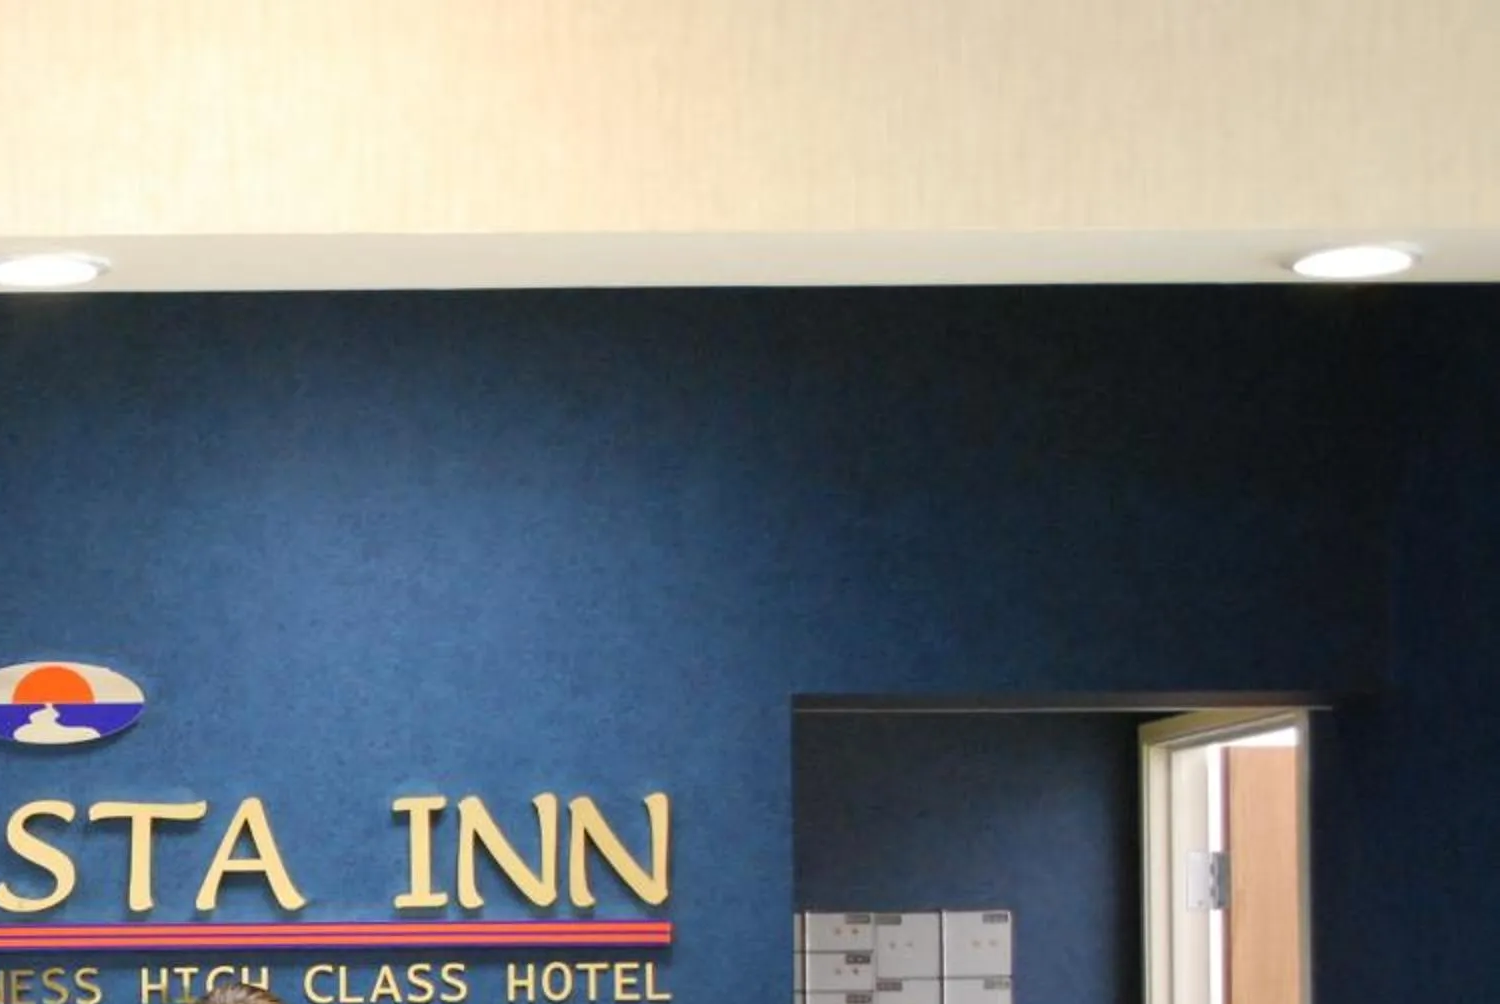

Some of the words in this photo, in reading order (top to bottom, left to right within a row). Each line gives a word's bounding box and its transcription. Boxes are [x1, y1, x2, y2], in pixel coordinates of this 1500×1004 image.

[393, 791, 672, 911] INN
[303, 961, 470, 1004] CLASS
[506, 960, 672, 1003] HOTEL
